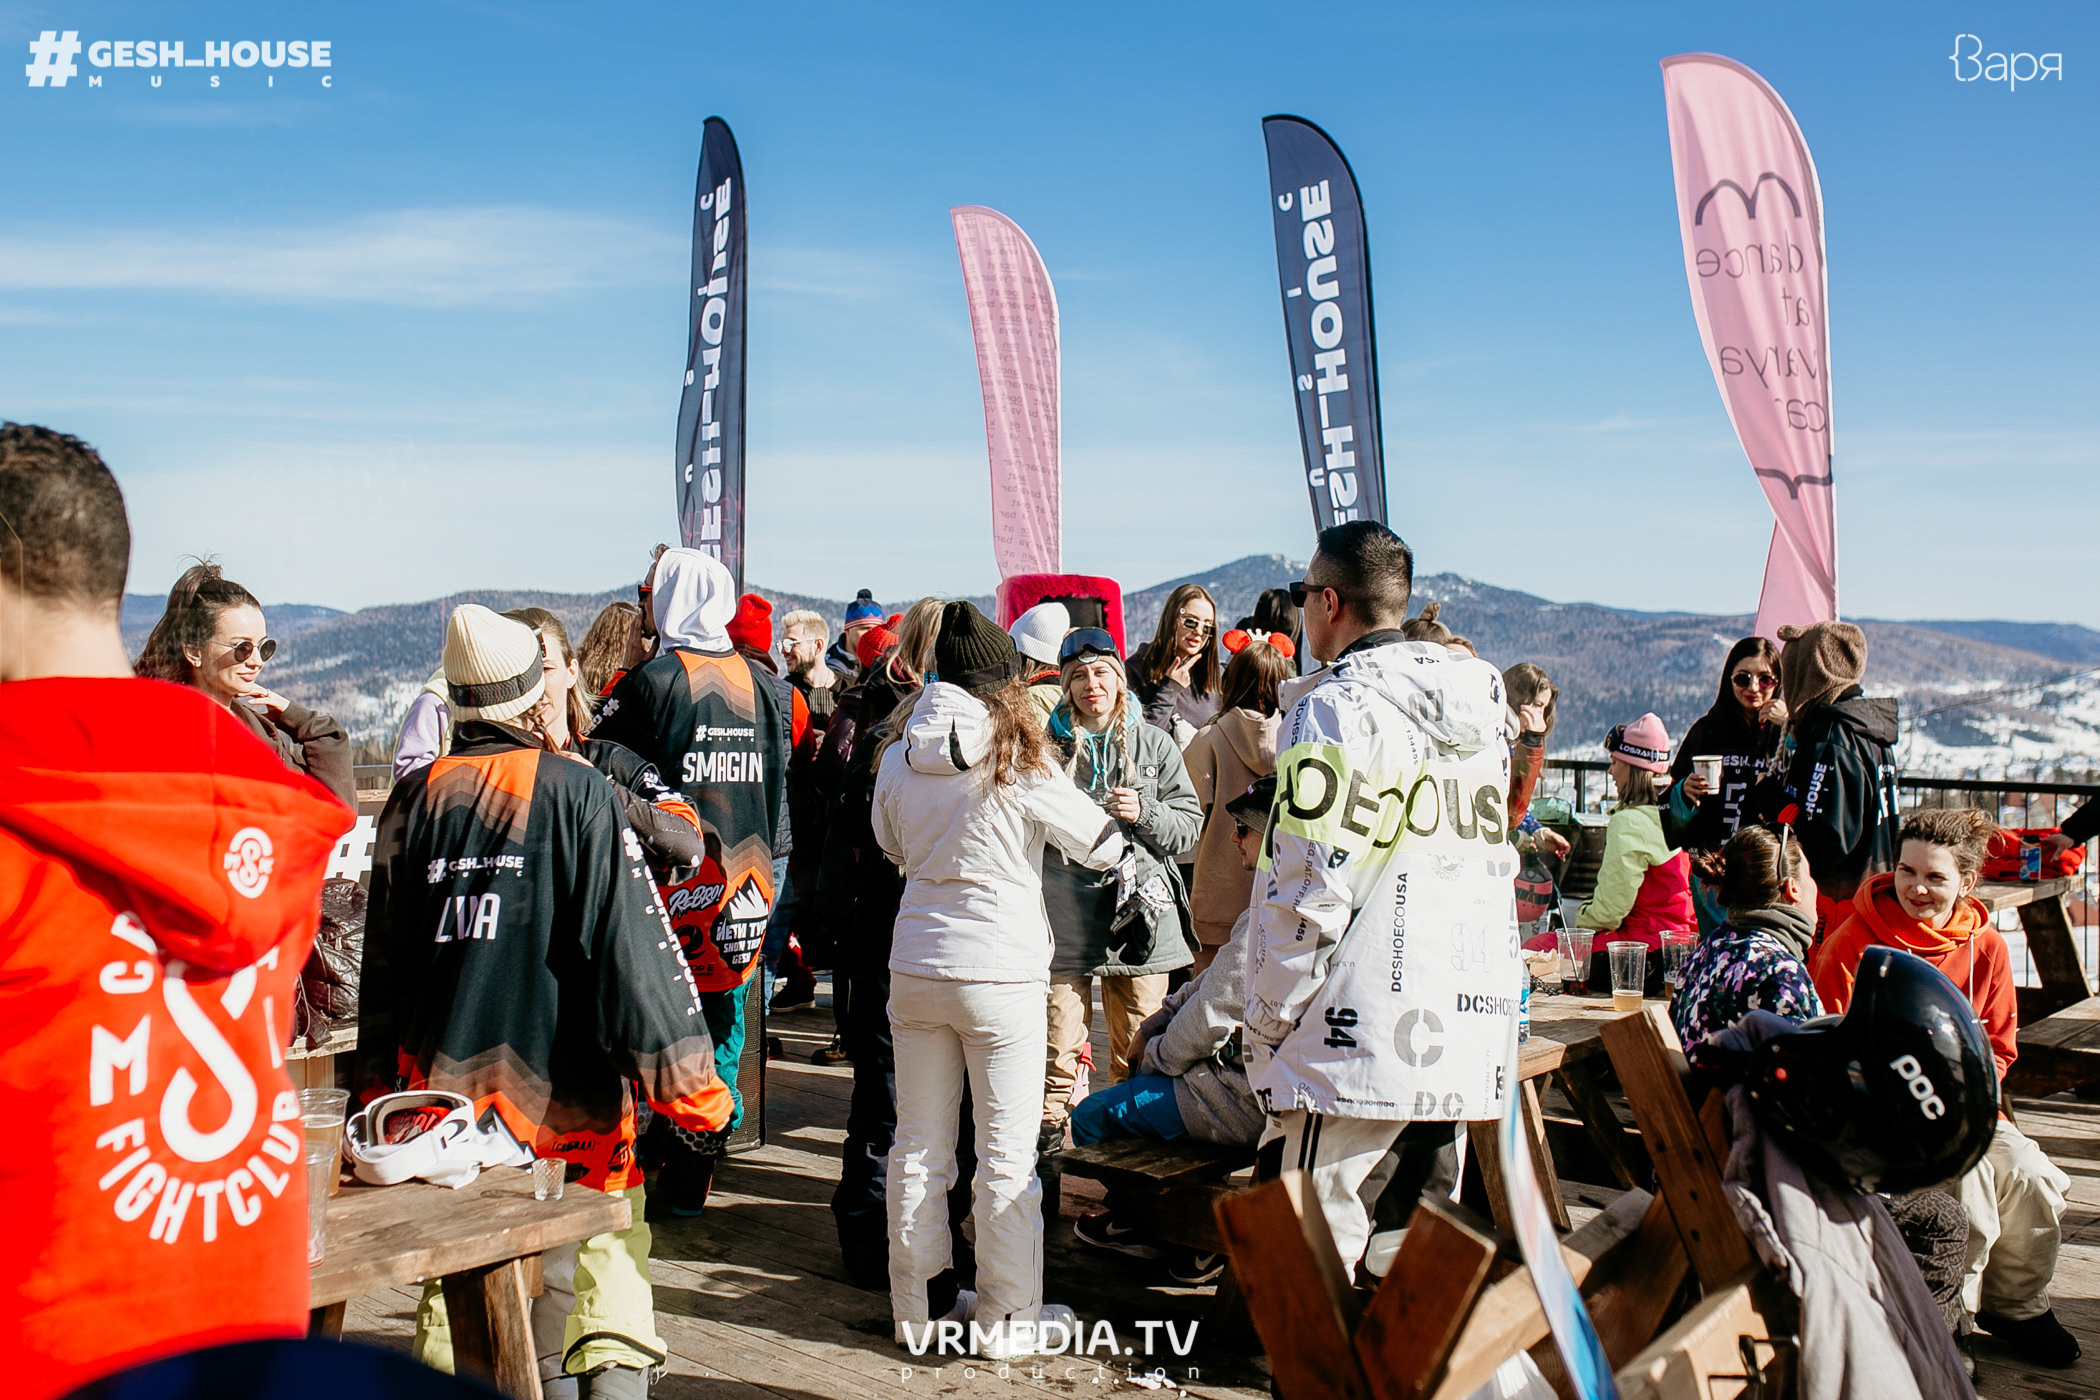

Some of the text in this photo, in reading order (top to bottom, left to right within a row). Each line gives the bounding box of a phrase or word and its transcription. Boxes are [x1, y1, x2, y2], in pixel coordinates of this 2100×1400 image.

[682, 751, 763, 782] SMAGIN
[1391, 872, 1408, 992] DCSHOECOUSA
[1323, 1006, 1360, 1049] 94
